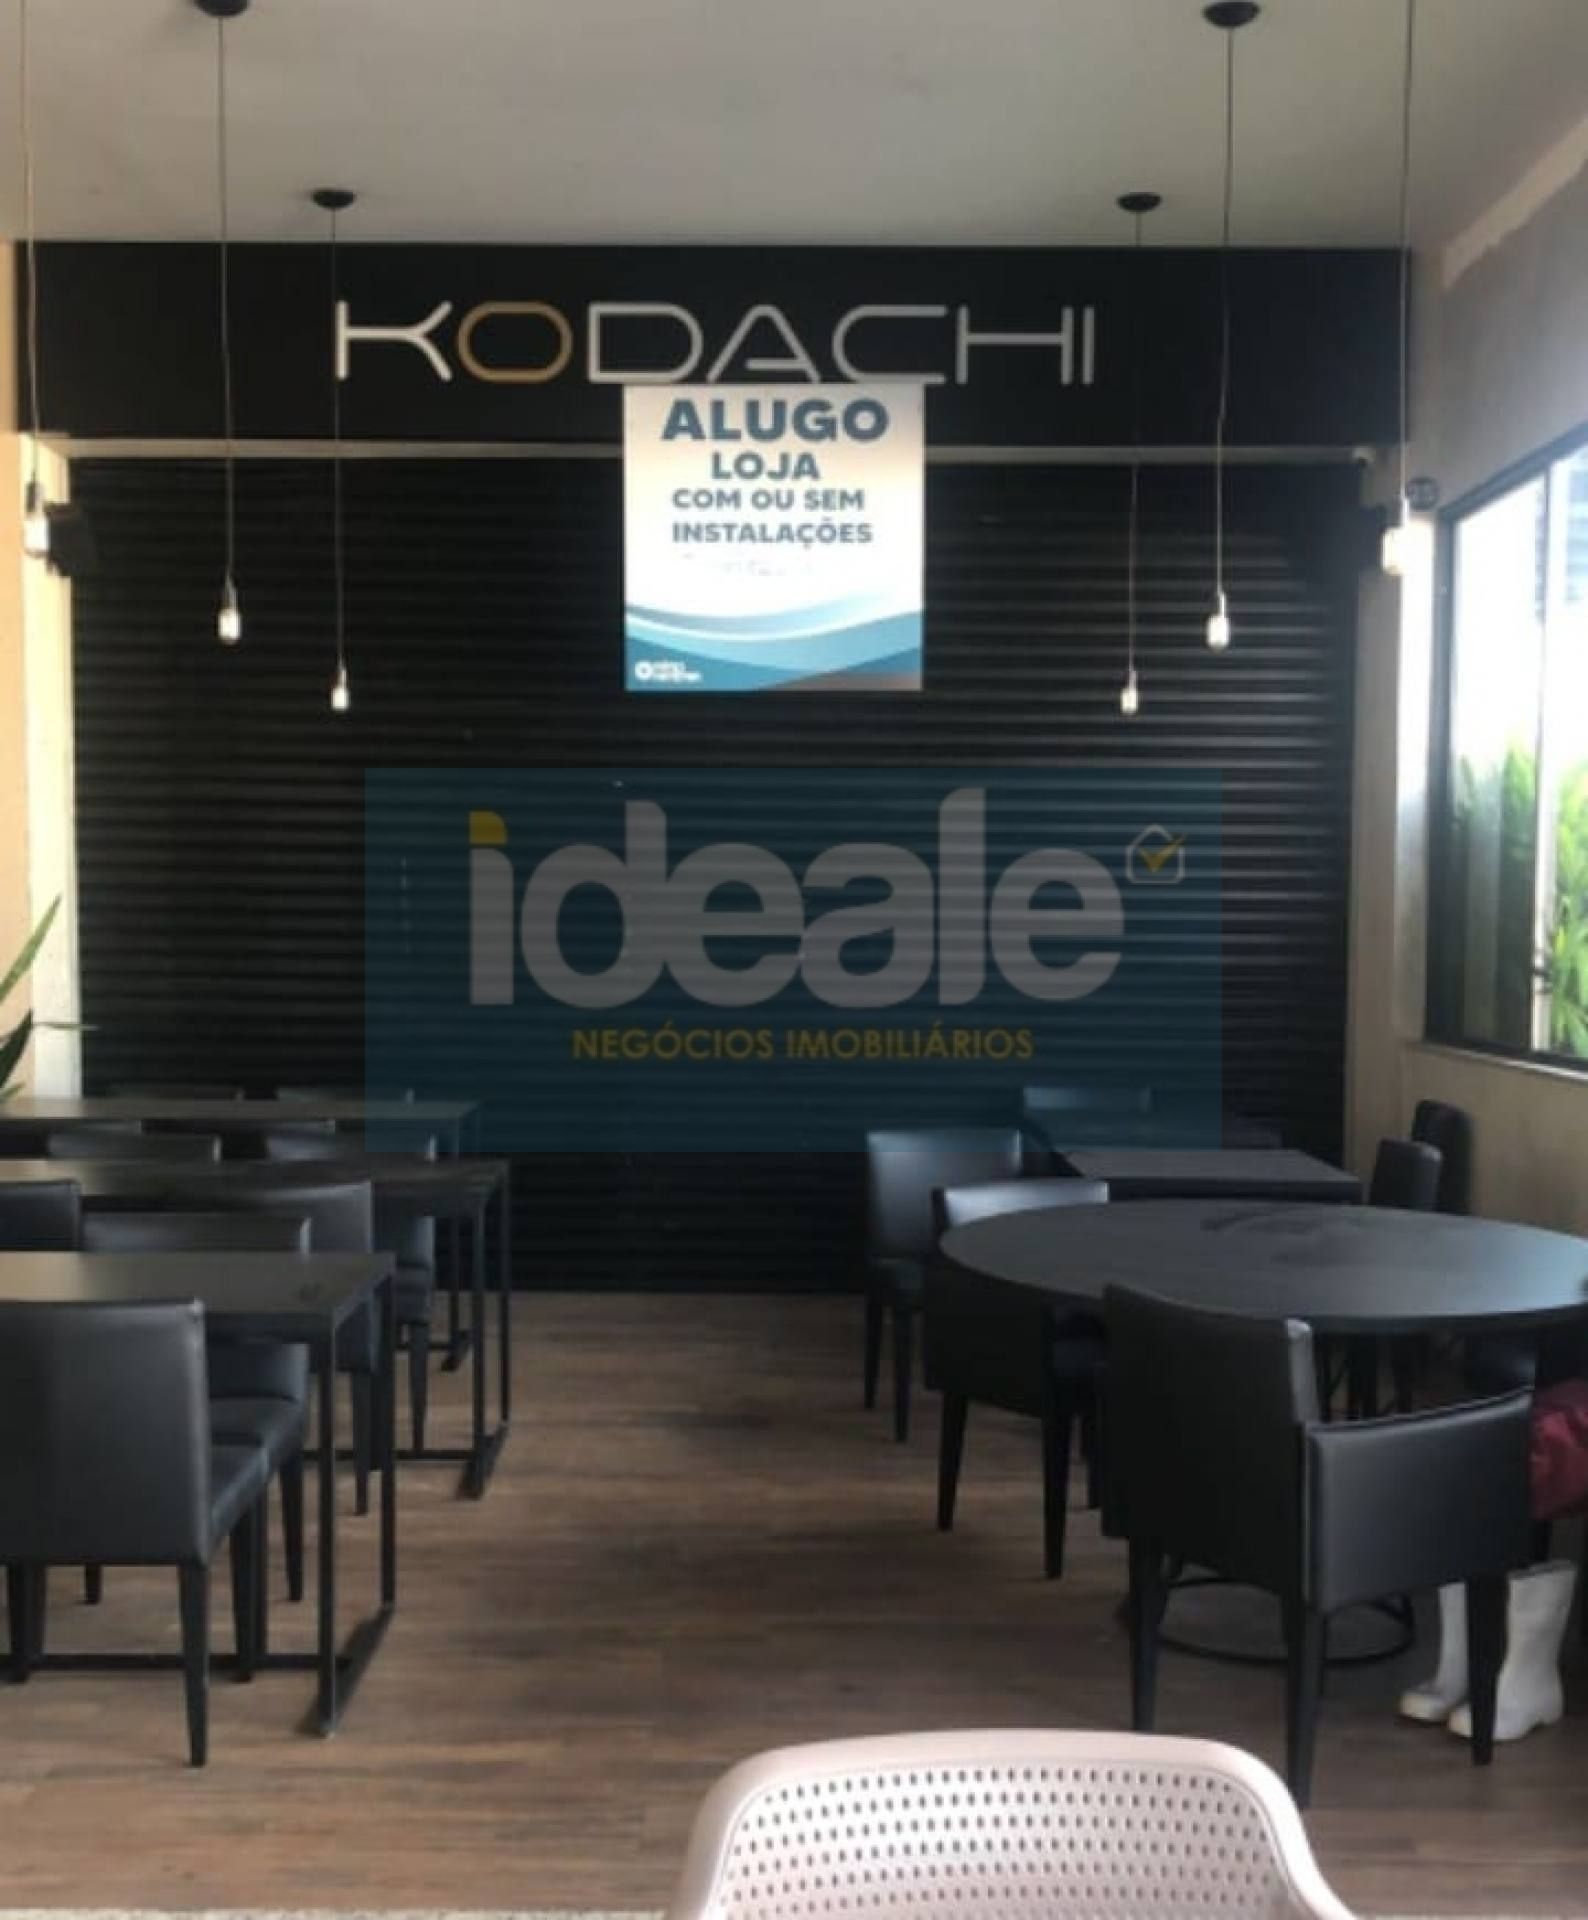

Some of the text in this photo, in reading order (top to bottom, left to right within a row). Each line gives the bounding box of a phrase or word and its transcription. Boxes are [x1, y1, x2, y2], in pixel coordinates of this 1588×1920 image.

[336, 300, 1095, 385] KODACHI
[661, 397, 890, 442] ALUGO
[711, 452, 821, 481] LOJA
[671, 488, 866, 511] COM OU SEM
[671, 517, 874, 549] INSTALAÇÕES
